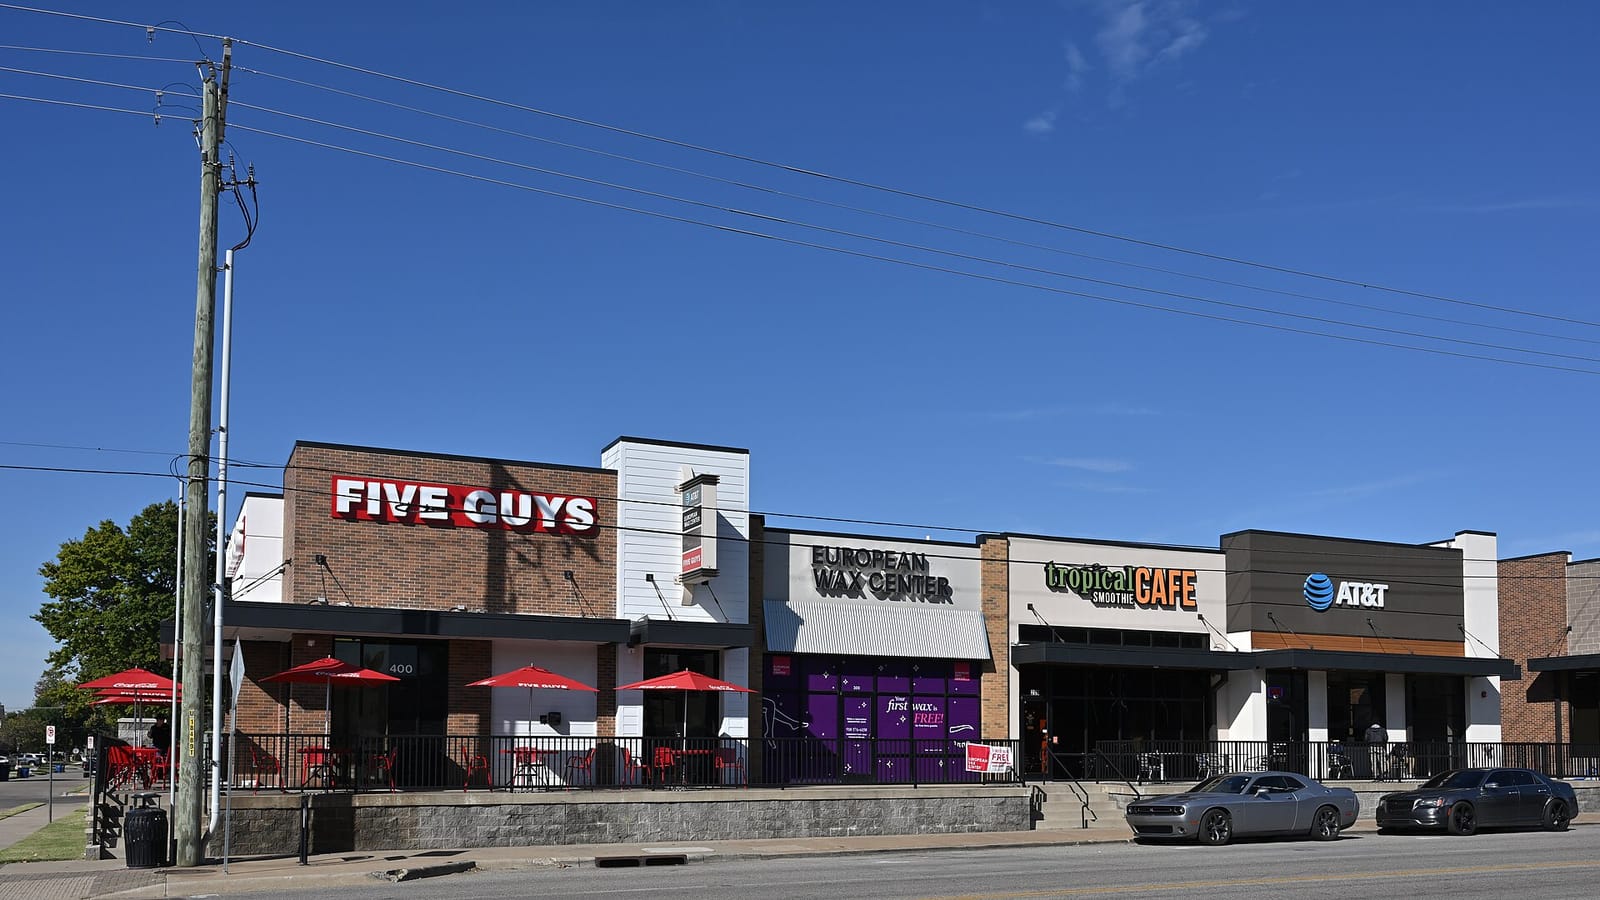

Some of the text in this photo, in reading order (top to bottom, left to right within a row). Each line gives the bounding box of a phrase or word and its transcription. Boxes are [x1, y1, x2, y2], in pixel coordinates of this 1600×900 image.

[336, 478, 594, 531] FIVE GUYS
[812, 545, 926, 571] EUROPEAN
[813, 568, 950, 597] WAX CENTER
[1046, 561, 1197, 607] tropical CAFE
[1335, 581, 1389, 608] AT&T
[1093, 592, 1135, 605] SMOOTHIE
[390, 664, 413, 674] 400
[886, 699, 908, 713] first
[912, 703, 933, 711] wax
[914, 713, 944, 723] FREE!
